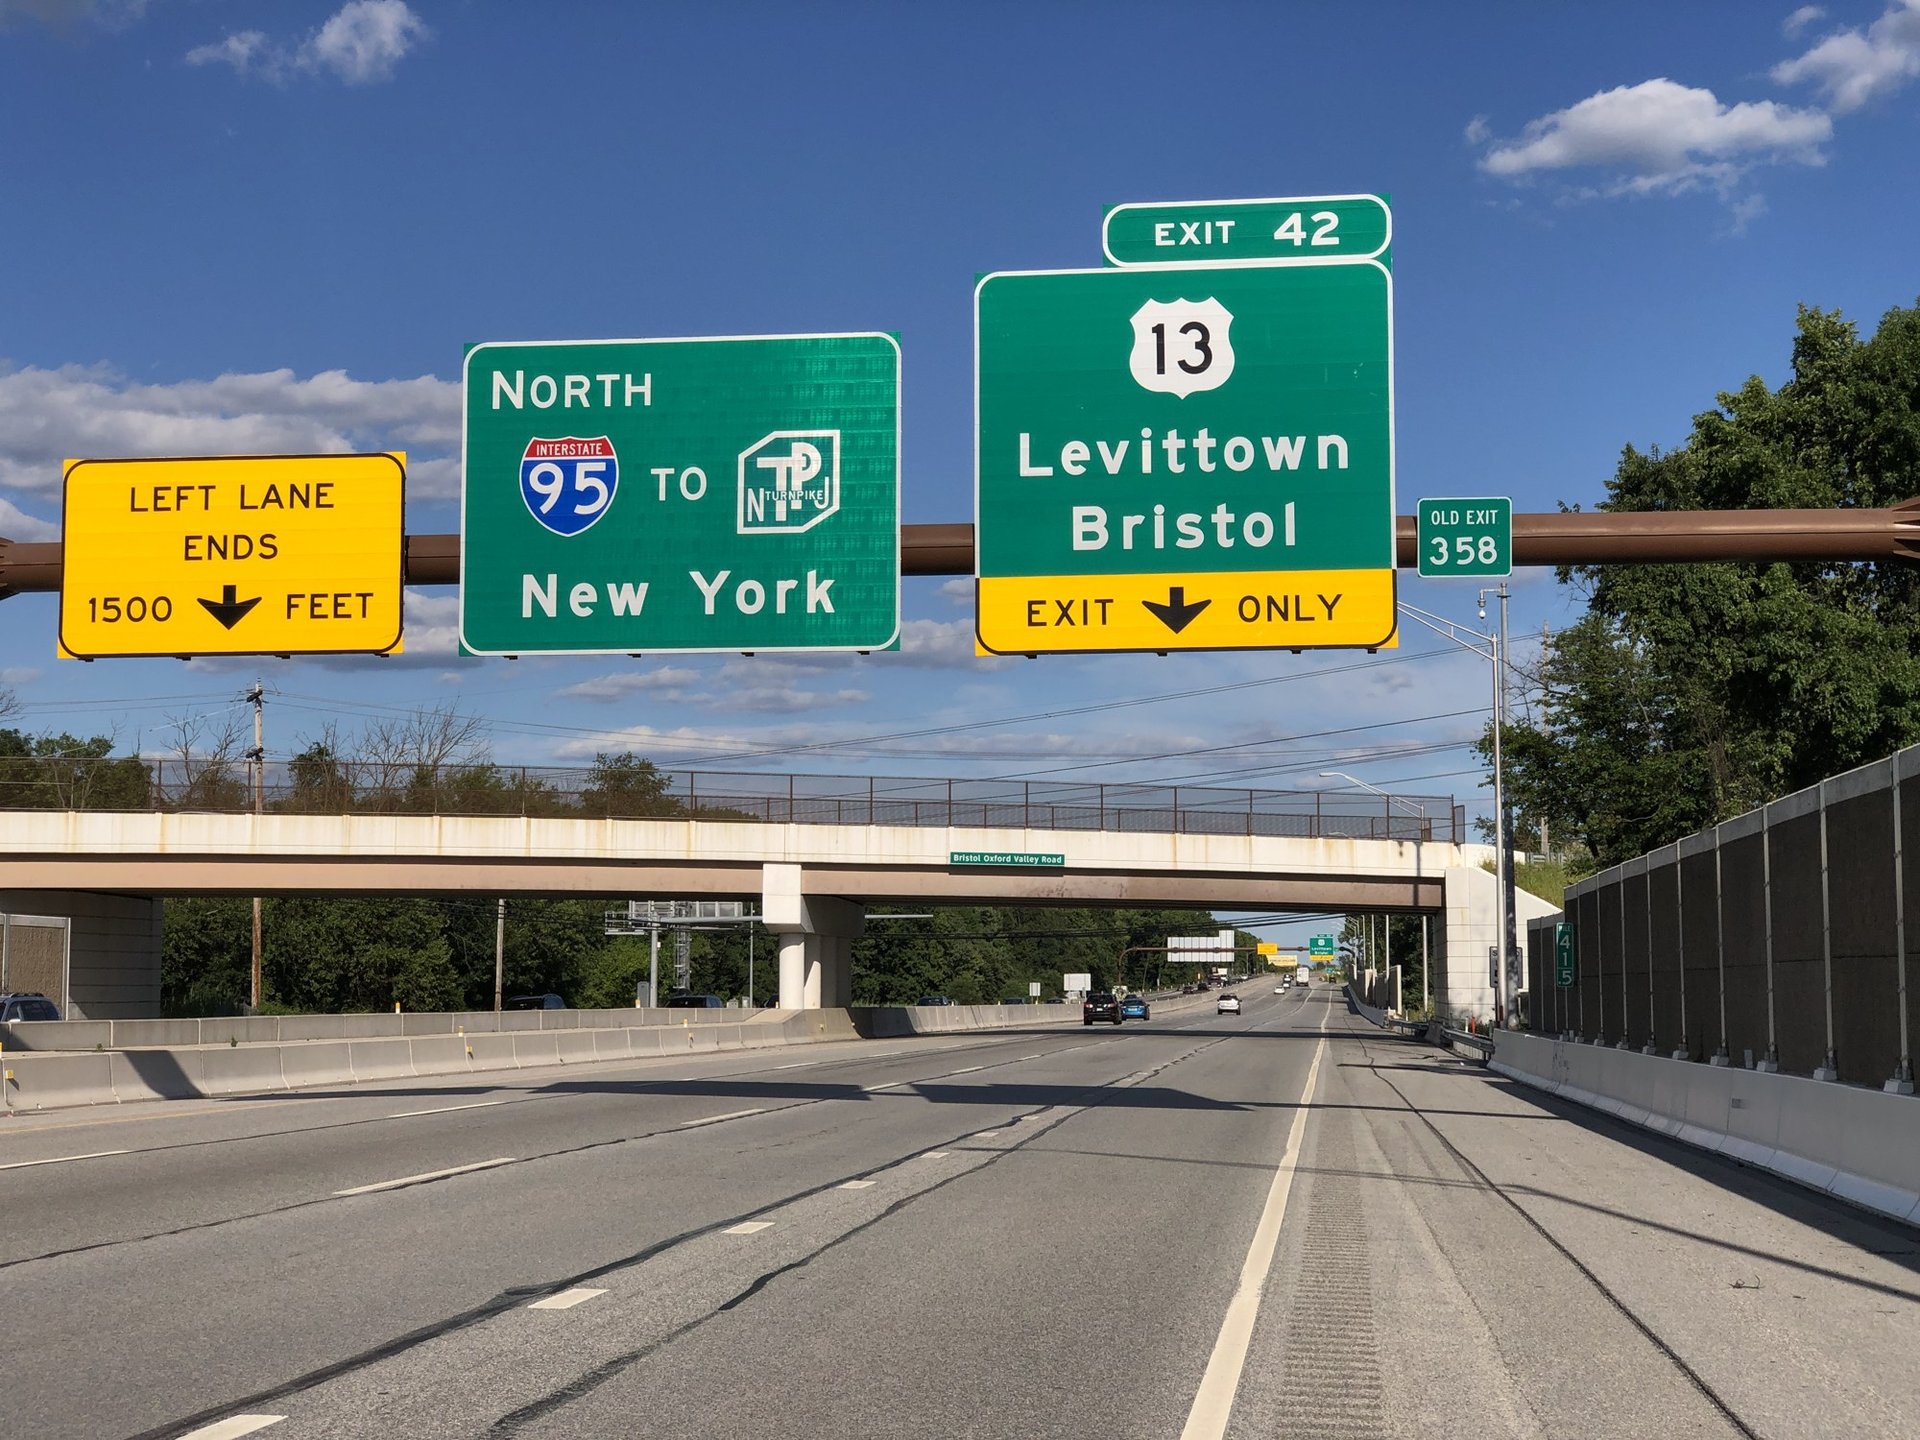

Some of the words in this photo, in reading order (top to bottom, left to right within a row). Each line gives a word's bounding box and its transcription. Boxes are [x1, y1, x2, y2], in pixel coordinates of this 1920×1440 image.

[1154, 220, 1236, 247] EXIT
[1273, 211, 1340, 247] 42
[1151, 321, 1213, 376] 13
[491, 370, 653, 410] NORTH
[536, 443, 603, 456] INTERSTATE
[1018, 427, 1350, 478] Levittown
[130, 485, 217, 513] LEFT
[239, 482, 335, 511] LANE
[529, 462, 609, 515] 95
[650, 466, 708, 502] TO
[765, 489, 824, 501] TURNPIKE
[1072, 501, 1297, 552] Bristol
[1431, 510, 1459, 525] OLD
[1466, 510, 1499, 525] EXIT
[183, 533, 279, 561] ENDS
[1429, 536, 1498, 565] 358
[88, 595, 173, 624] 1500
[286, 592, 374, 620] FEET
[521, 573, 650, 619] New
[688, 569, 836, 616] York
[1026, 598, 1114, 627] EXIT
[1237, 593, 1343, 623] ONLY
[953, 854, 981, 862] Bristol
[983, 855, 1012, 863] Oxford
[1013, 856, 1039, 865] Valley
[1041, 856, 1062, 864] Road
